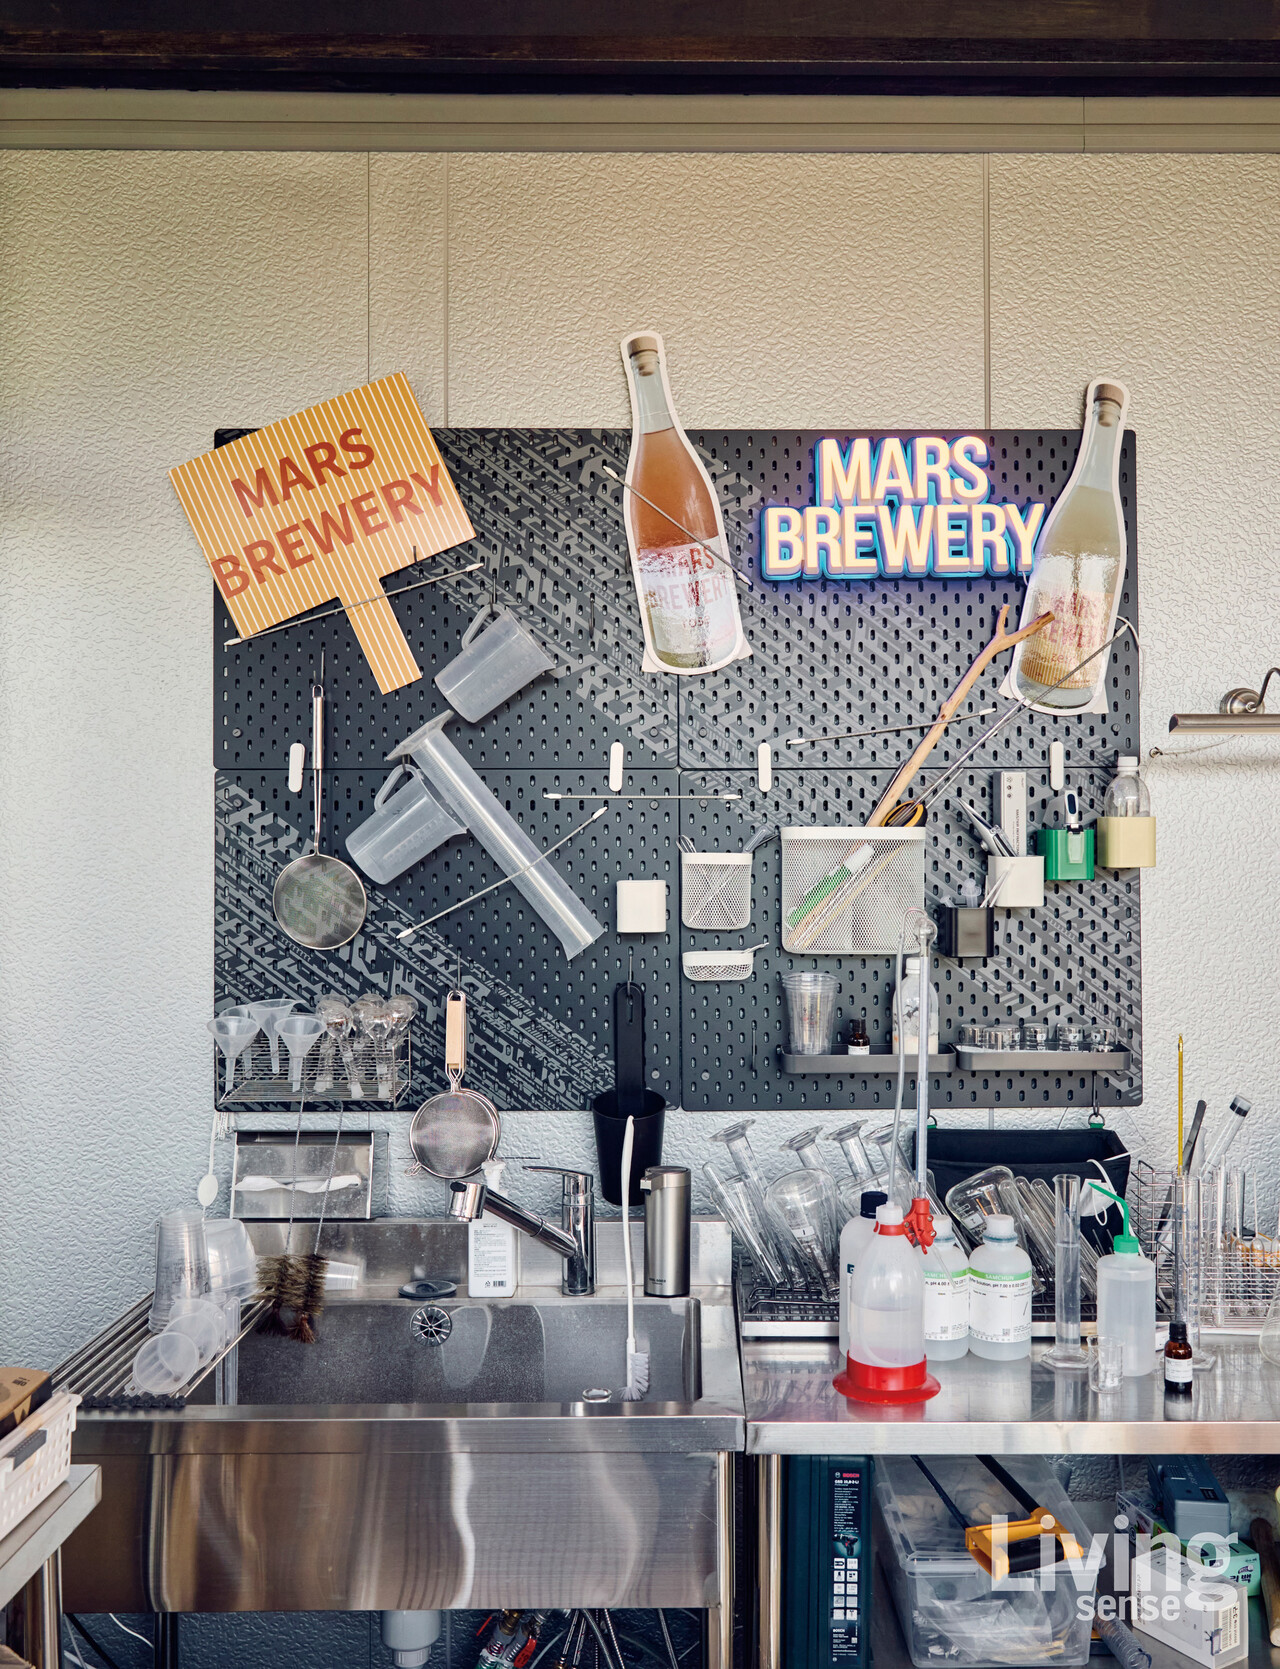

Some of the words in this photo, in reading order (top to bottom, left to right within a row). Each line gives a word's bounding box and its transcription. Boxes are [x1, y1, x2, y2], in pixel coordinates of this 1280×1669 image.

[231, 428, 375, 517] MARS
[819, 436, 990, 505] MARS
[212, 464, 441, 599] BREWERY
[763, 503, 1046, 574] BREWERY
